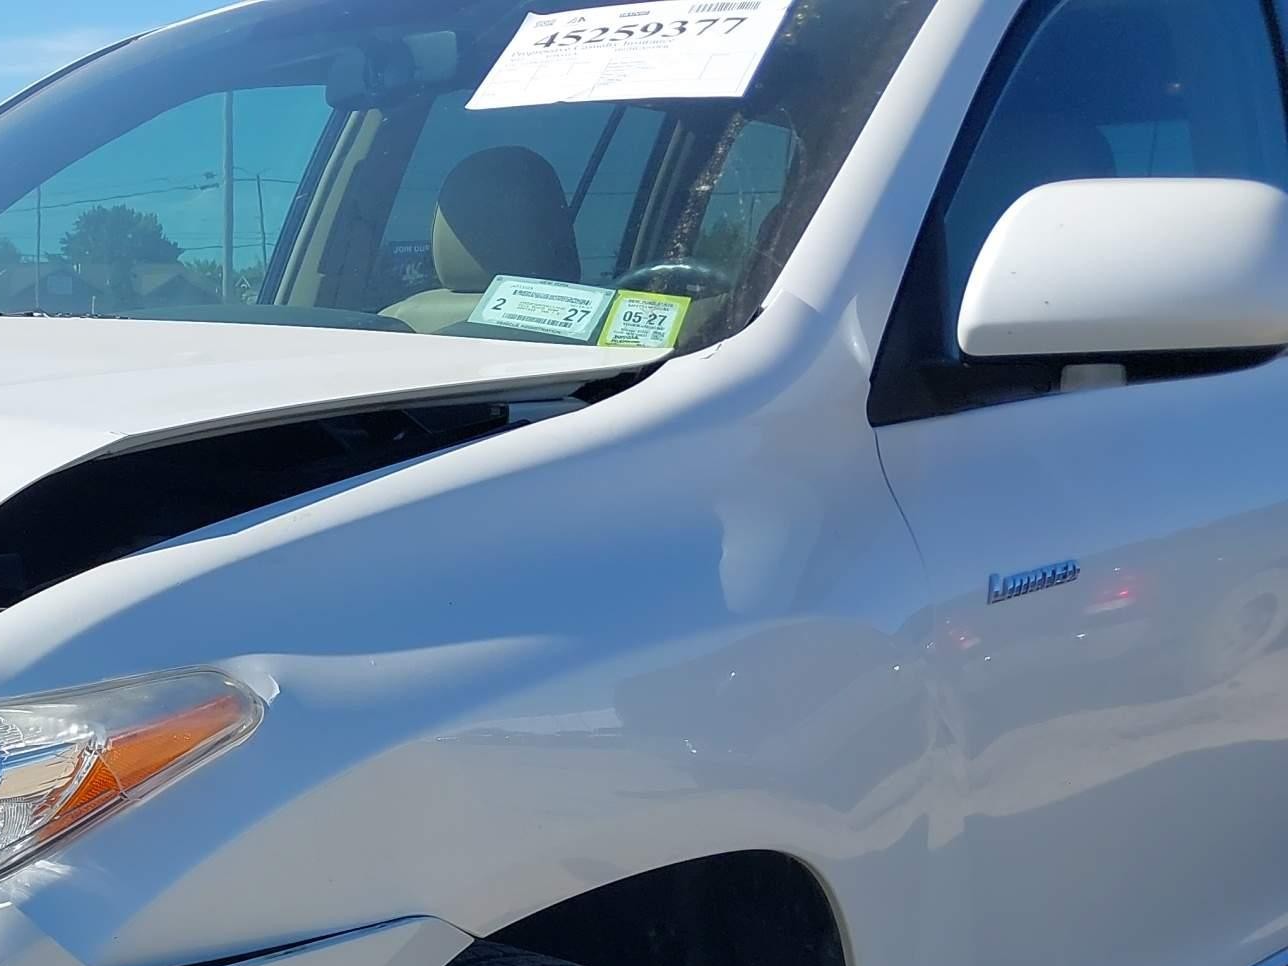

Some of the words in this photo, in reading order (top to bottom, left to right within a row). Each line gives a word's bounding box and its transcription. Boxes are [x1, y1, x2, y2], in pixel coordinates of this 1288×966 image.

[533, 17, 749, 48] 45259377
[492, 297, 507, 311] 2
[563, 308, 591, 323] 27
